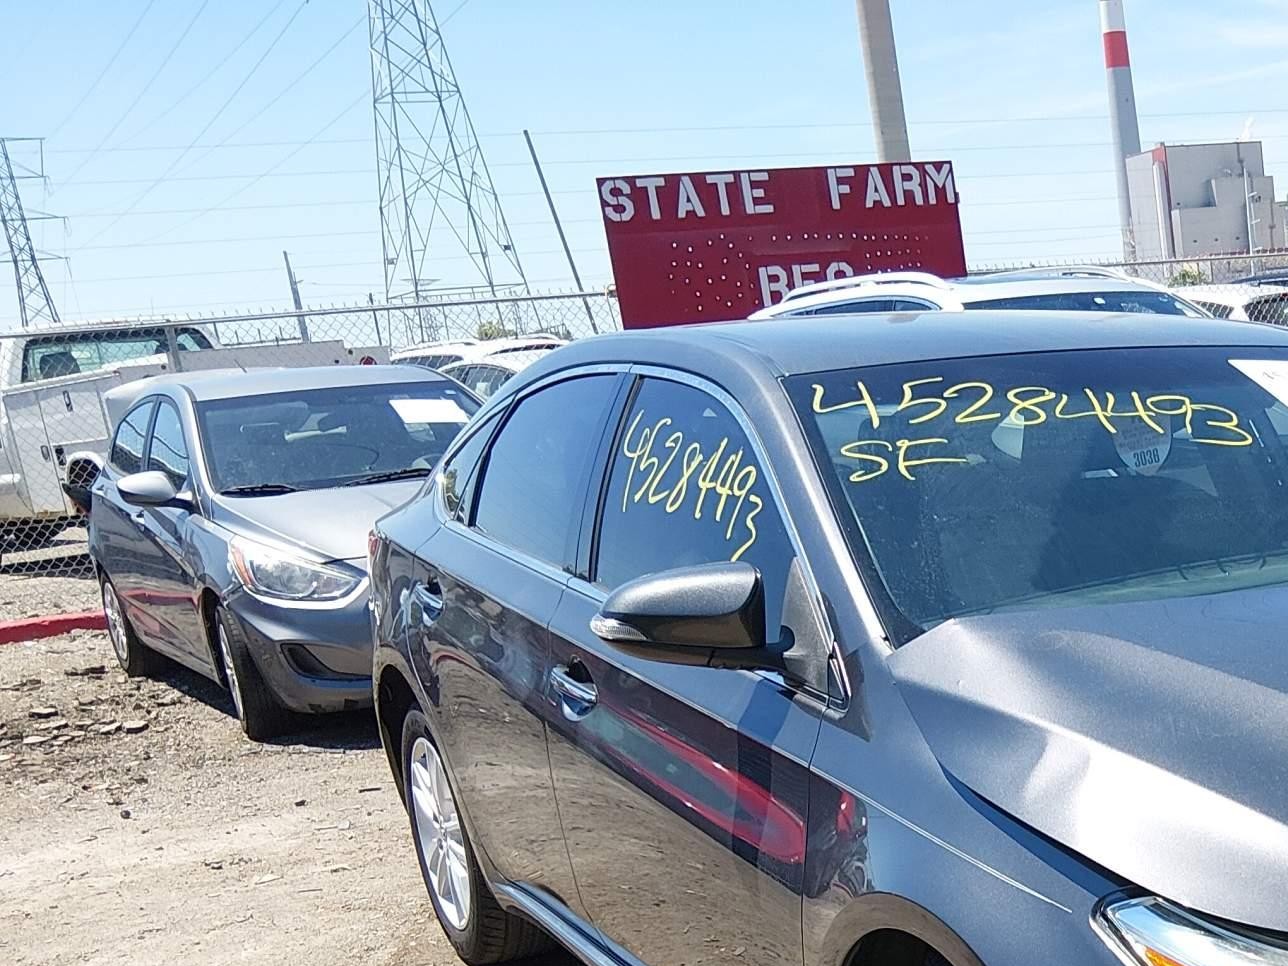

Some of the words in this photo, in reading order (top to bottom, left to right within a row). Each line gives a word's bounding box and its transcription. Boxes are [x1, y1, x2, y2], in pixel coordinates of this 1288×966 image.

[600, 171, 775, 222] STATE
[827, 163, 956, 210] FARM
[811, 376, 1253, 447] 45284493
[622, 409, 763, 563] 45284493
